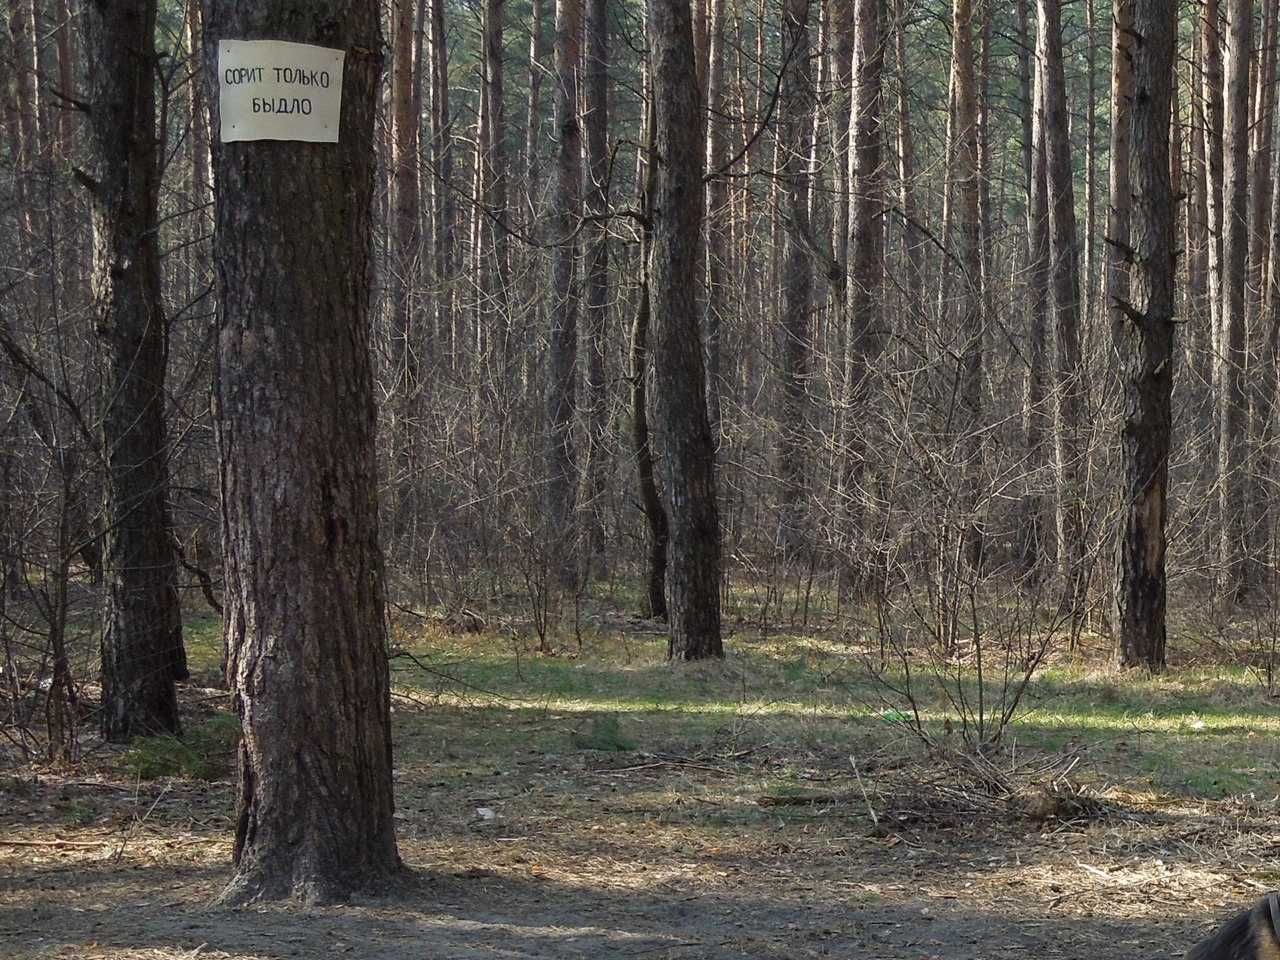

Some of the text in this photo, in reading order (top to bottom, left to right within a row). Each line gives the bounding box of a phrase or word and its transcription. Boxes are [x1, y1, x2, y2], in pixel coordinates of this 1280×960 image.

[225, 67, 330, 88] СОРИТ ТОЛЬКО
[252, 97, 312, 115] БЫДЛО
